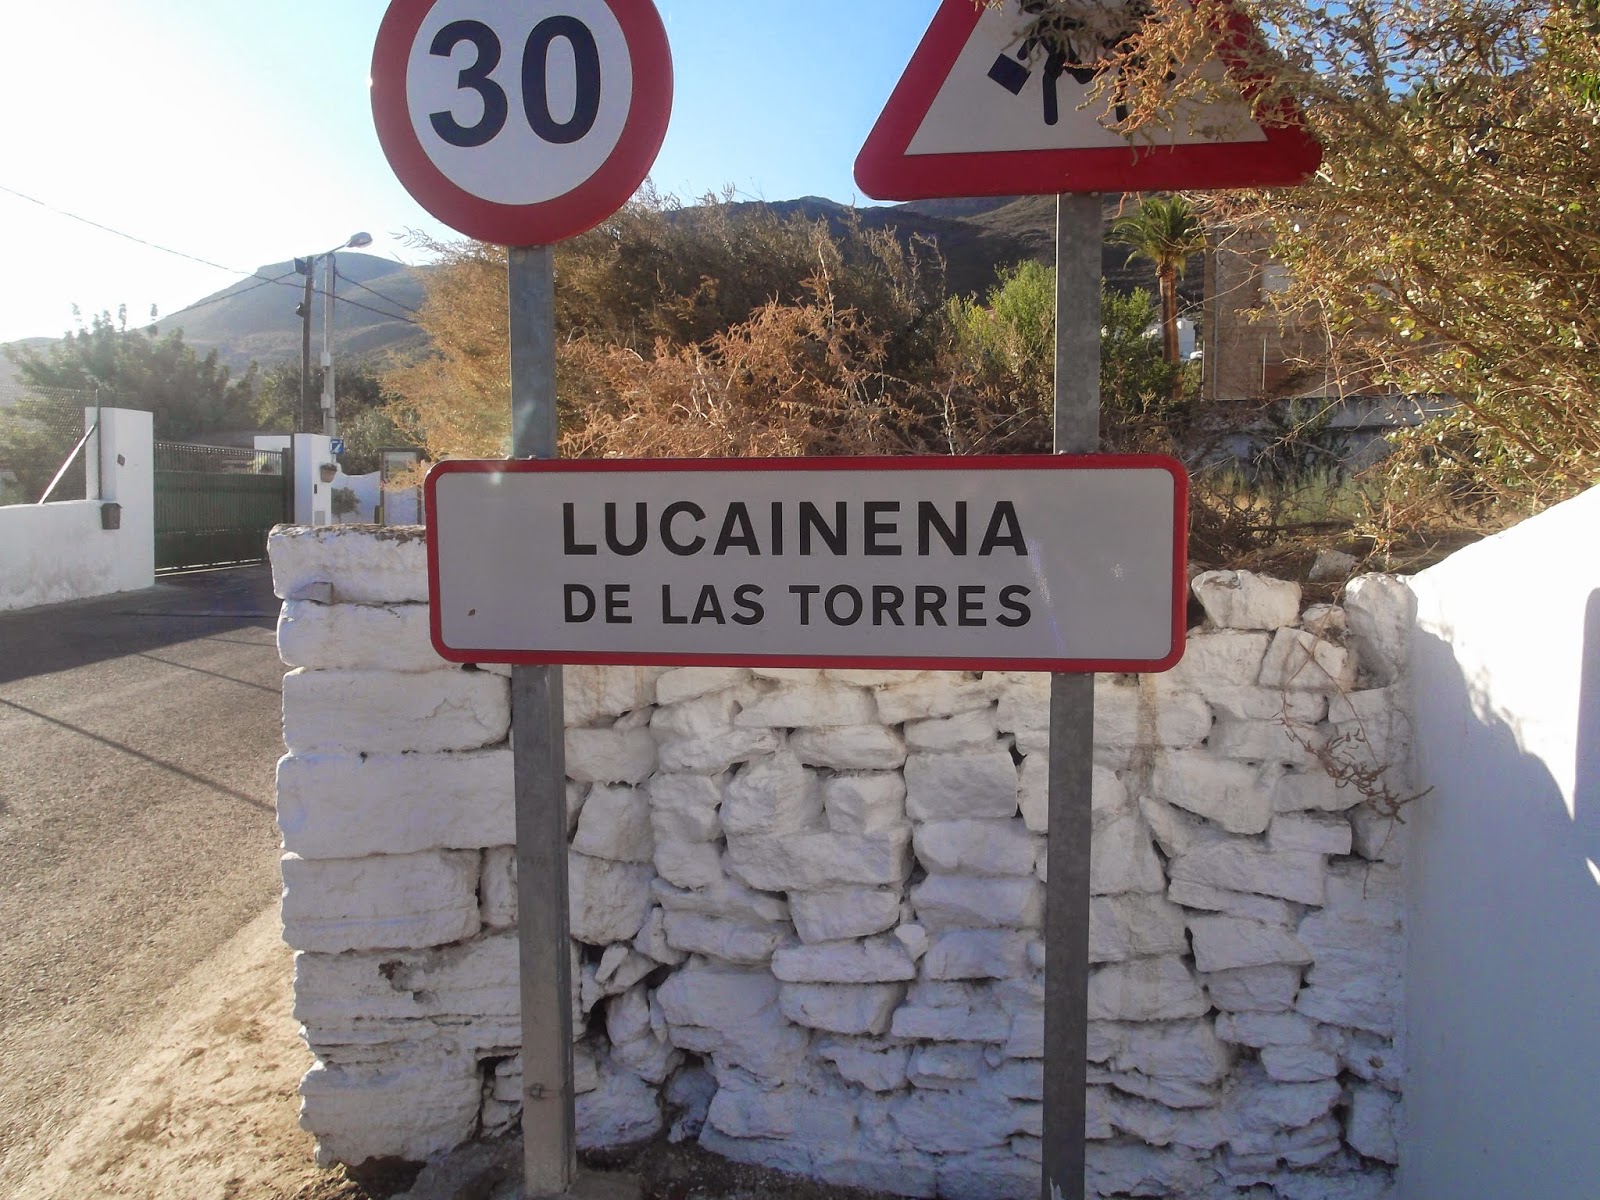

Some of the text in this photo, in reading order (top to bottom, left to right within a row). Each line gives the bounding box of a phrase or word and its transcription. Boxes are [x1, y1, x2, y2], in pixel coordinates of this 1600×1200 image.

[429, 15, 601, 148] 30
[562, 500, 1029, 557] LUCAINENA
[563, 583, 1032, 628] DE LAS TORRES
